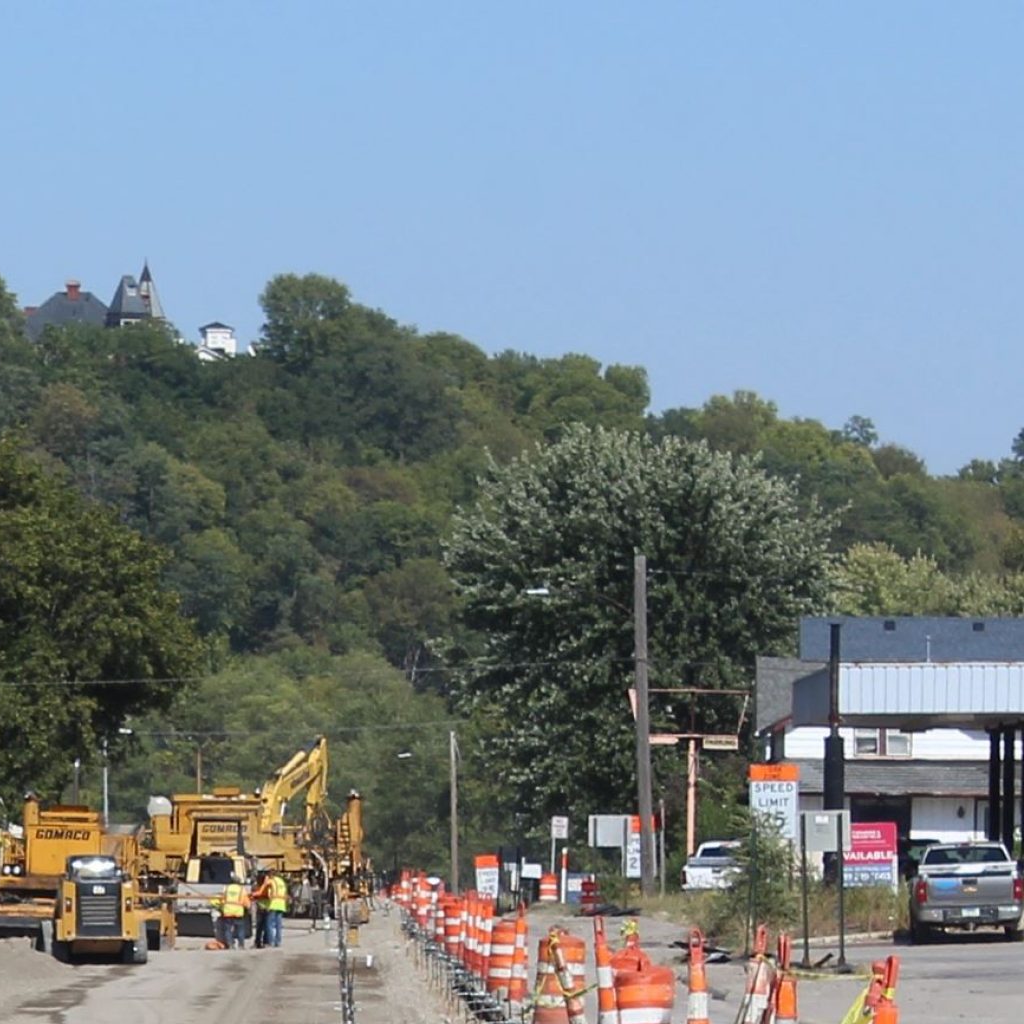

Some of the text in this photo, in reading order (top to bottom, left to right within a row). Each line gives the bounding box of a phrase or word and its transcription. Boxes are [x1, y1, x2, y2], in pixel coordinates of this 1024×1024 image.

[754, 783, 793, 793] SPEED
[758, 798, 789, 807] LIMIT
[36, 829, 91, 840] GOMACO
[842, 850, 894, 861] VAILABLE
